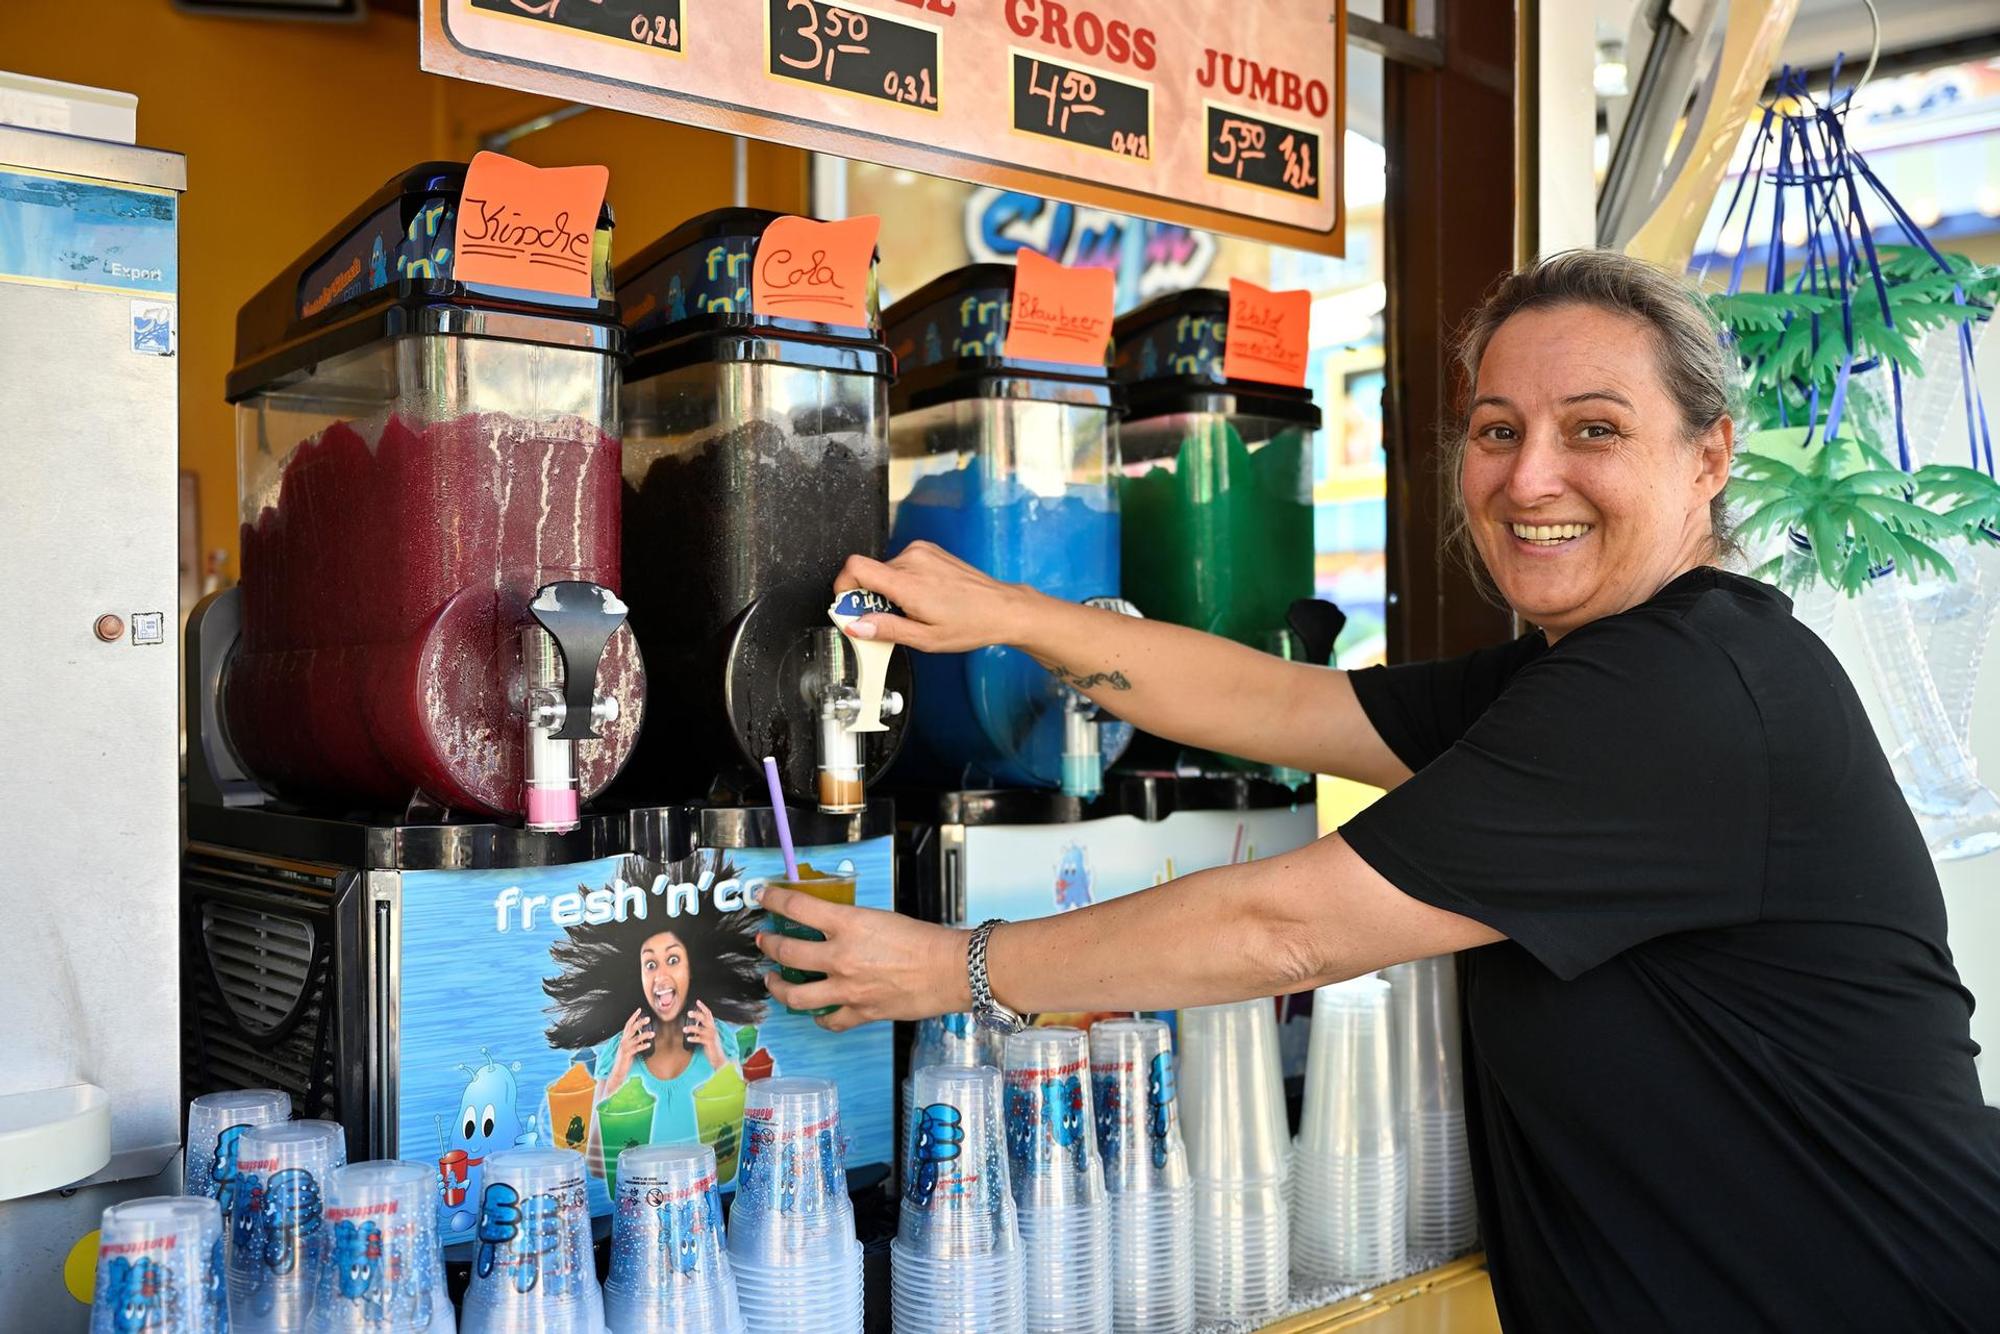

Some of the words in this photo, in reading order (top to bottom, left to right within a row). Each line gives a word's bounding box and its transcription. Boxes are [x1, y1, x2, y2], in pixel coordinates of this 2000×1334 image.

[1005, 0, 1156, 71] GROSS
[1197, 49, 1329, 118] JUMBO
[111, 262, 162, 281] Export
[762, 249, 844, 289] Cola
[494, 871, 768, 933] fresh'n'co
